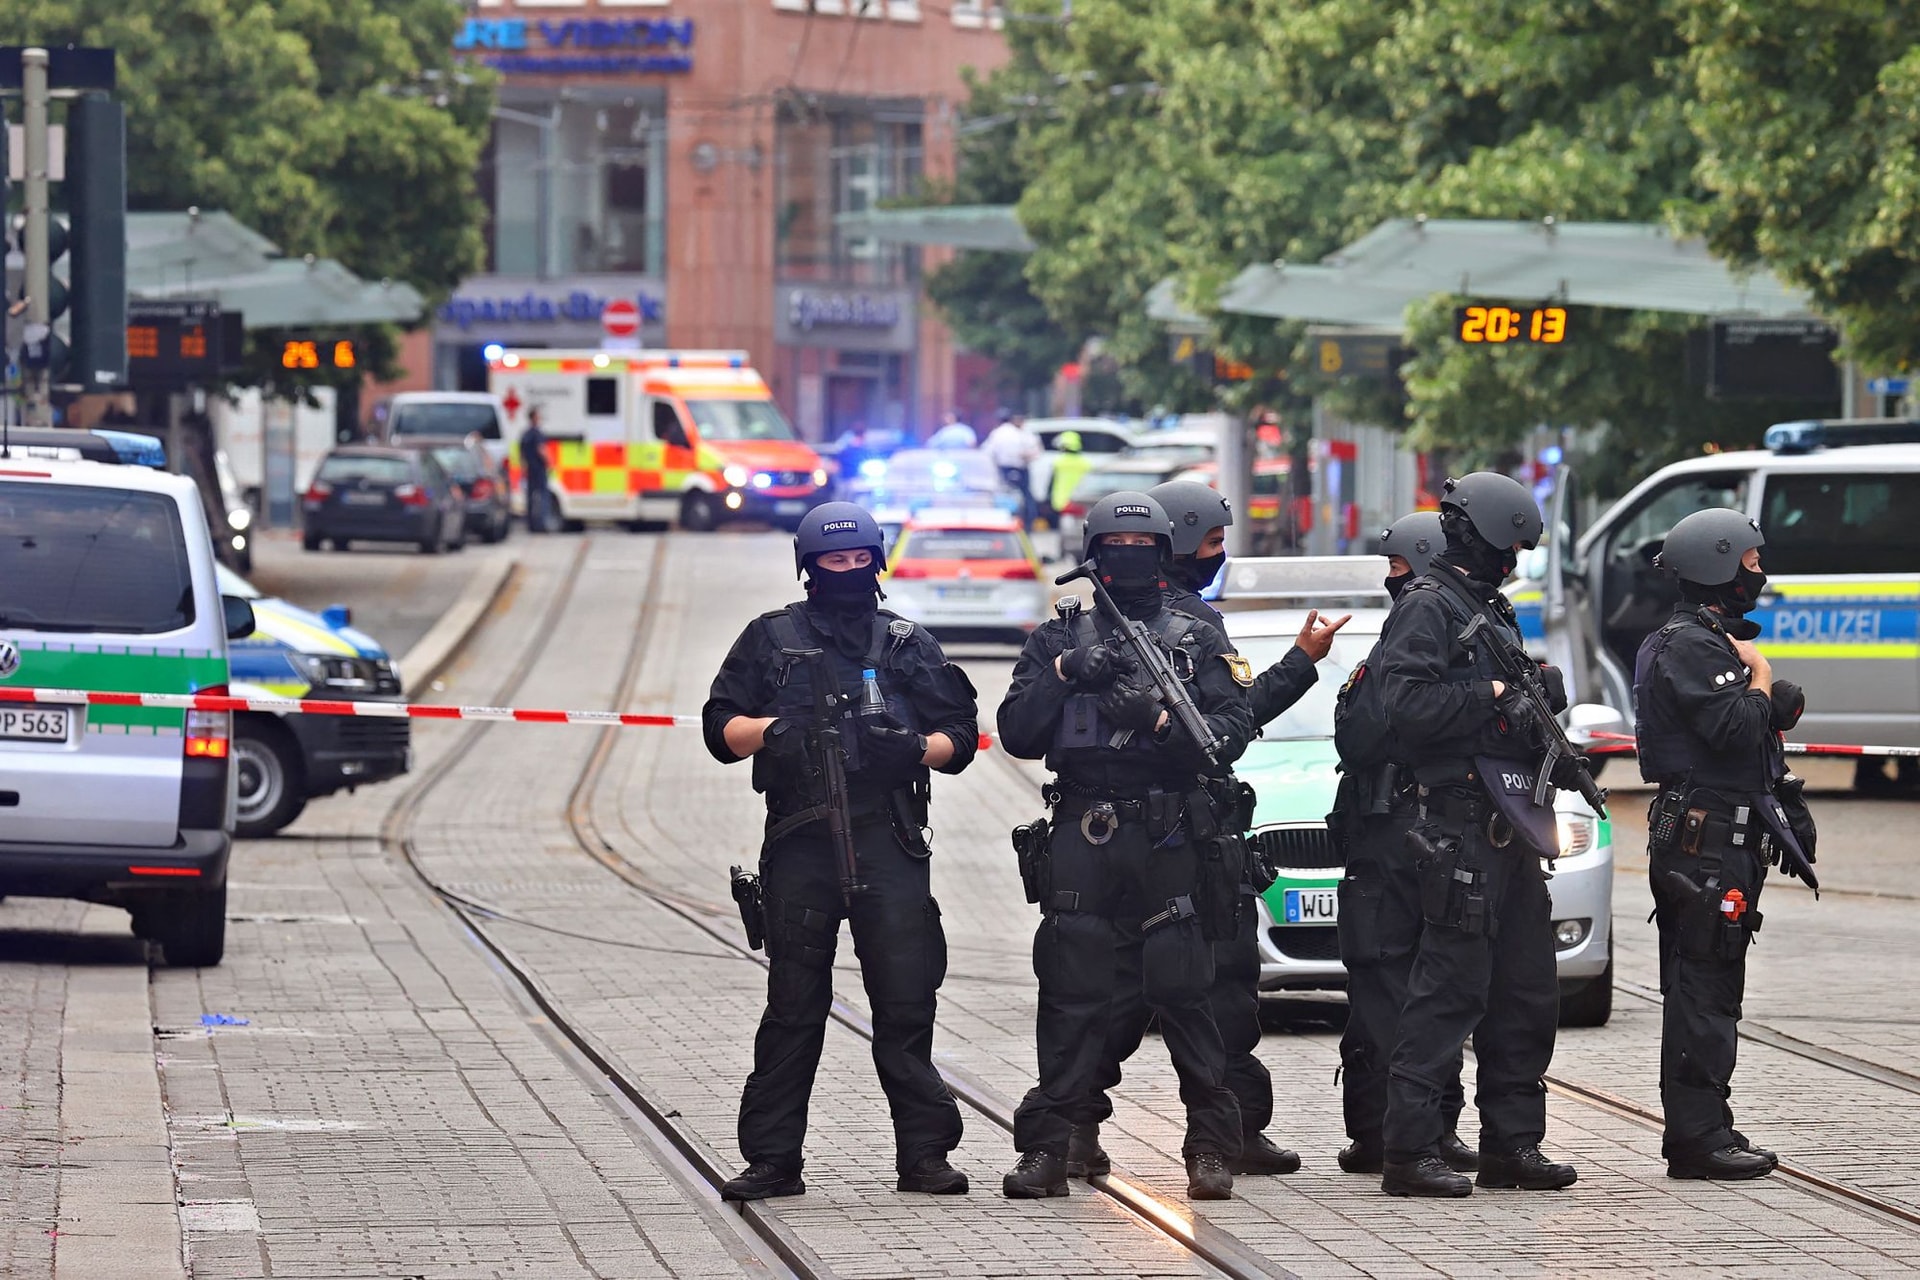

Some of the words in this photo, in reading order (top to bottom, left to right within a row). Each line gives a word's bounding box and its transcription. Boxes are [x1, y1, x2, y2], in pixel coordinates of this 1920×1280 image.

[1461, 306, 1567, 342] 20:13
[1116, 506, 1149, 514] POLIZEI
[824, 521, 856, 531] POLIZEI
[1773, 609, 1880, 640] POLIZEI
[0, 711, 17, 733] P
[21, 712, 63, 735] 563
[1502, 773, 1534, 790] POLI
